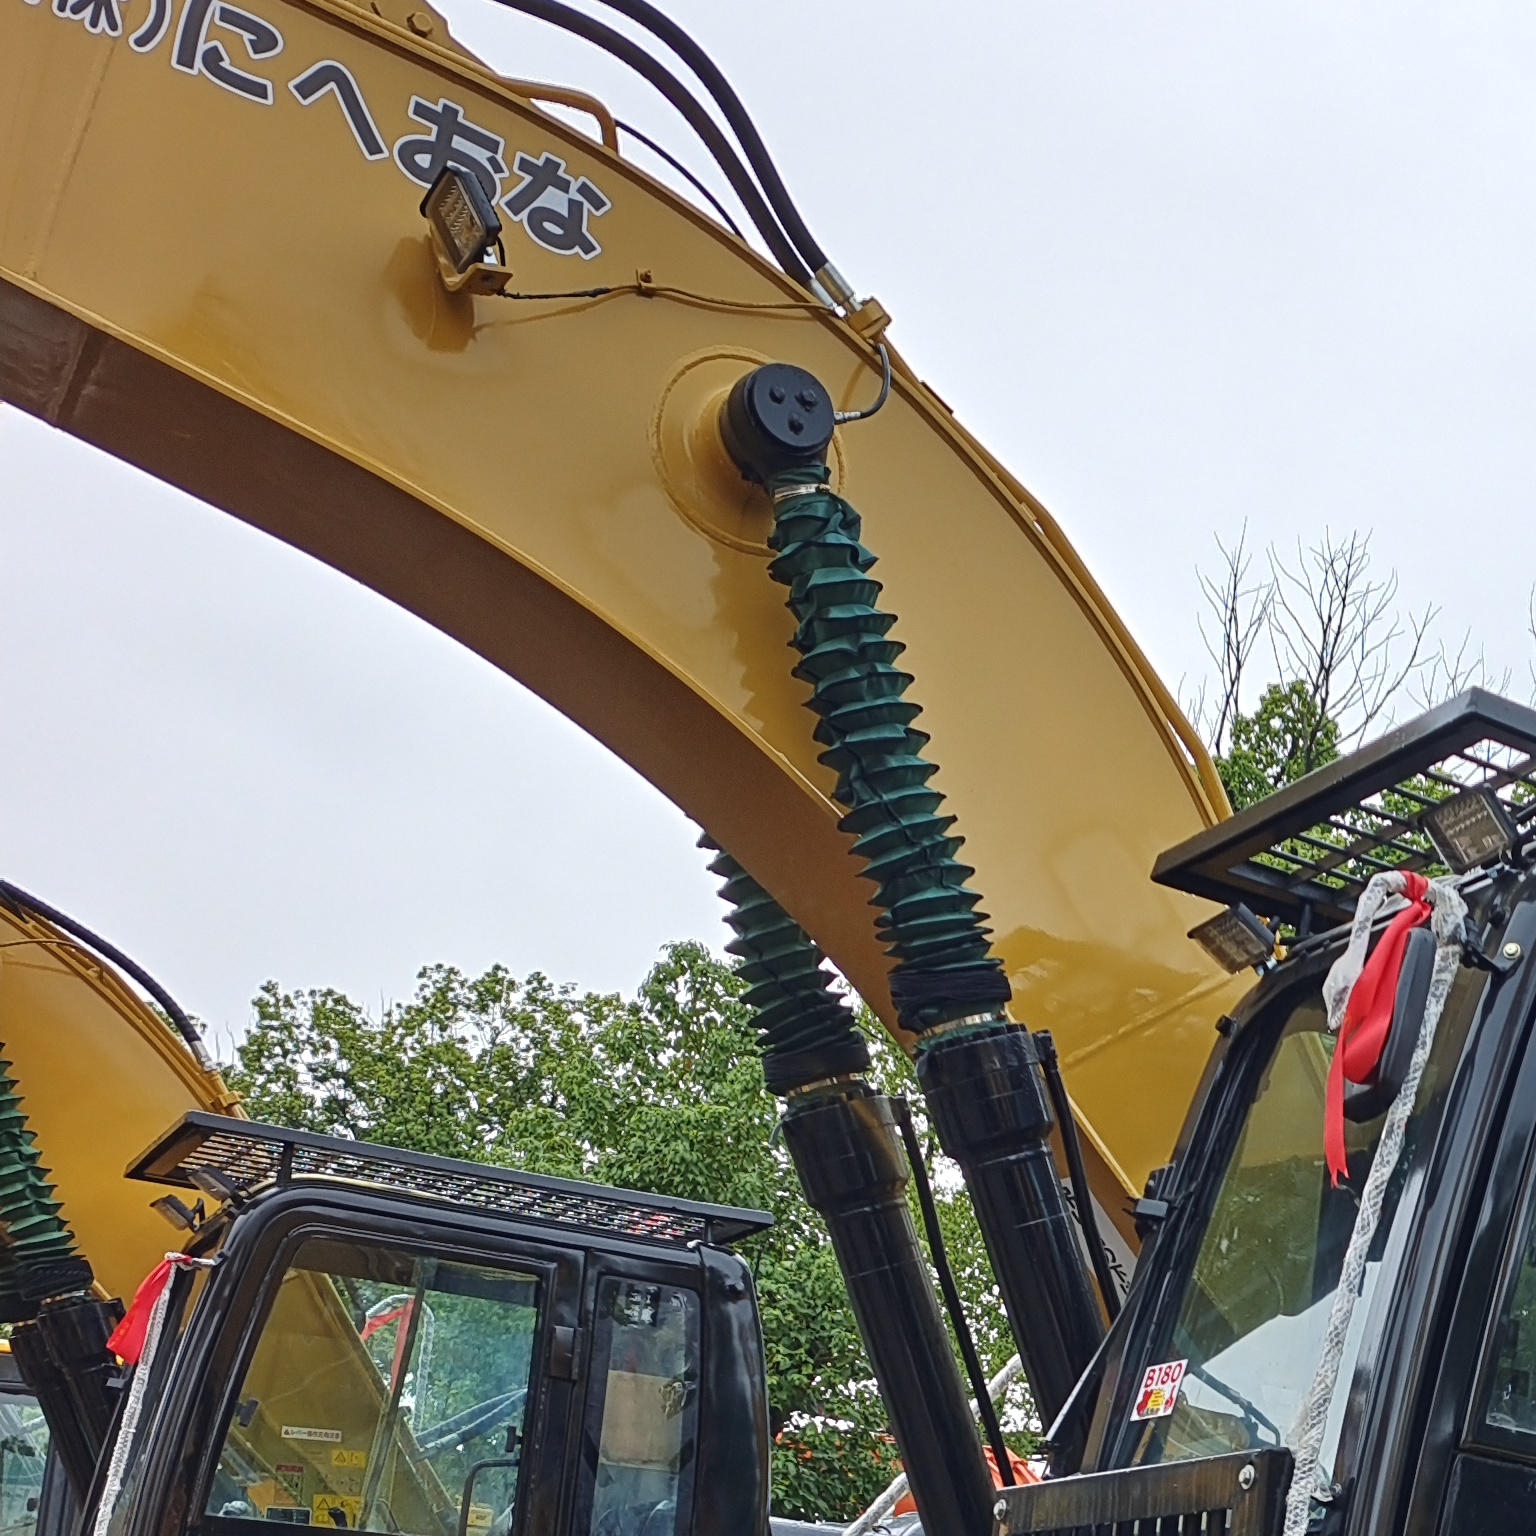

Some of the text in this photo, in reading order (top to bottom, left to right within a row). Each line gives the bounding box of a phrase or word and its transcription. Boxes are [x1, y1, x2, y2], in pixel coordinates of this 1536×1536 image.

[24, 0, 612, 259] )にへおな
[1144, 1363, 1183, 1388] B180
